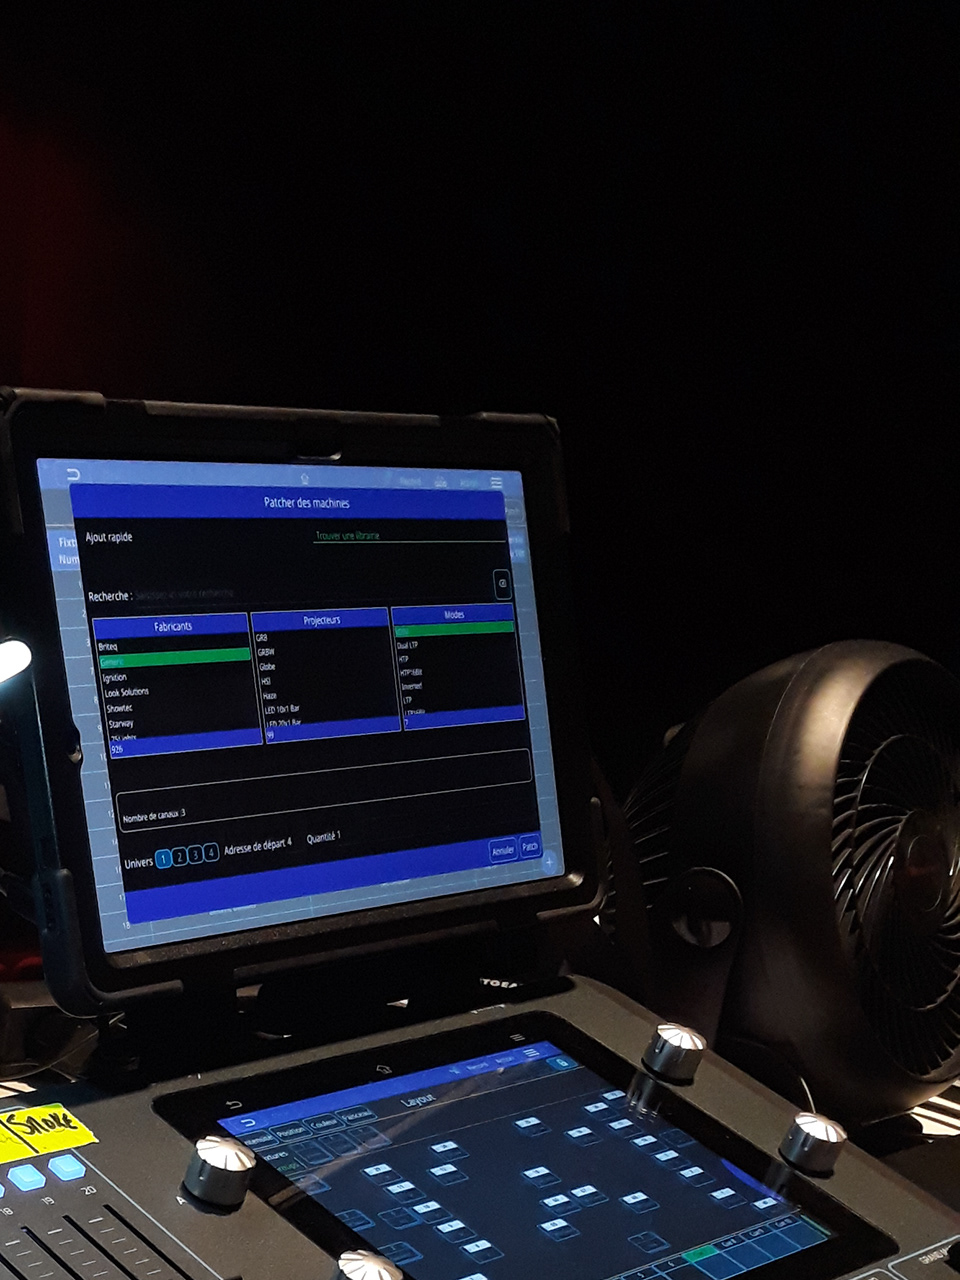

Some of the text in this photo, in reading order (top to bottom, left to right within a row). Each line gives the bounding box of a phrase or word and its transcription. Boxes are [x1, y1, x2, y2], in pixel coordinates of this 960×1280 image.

[264, 497, 351, 510] Patcher des machines
[86, 532, 133, 545] Ajout rapide
[88, 590, 129, 602] Recherche
[303, 615, 341, 627] Projecteurs
[444, 610, 465, 620] Modes
[154, 621, 193, 632] Fabricants
[98, 643, 119, 653] Briteq
[259, 663, 276, 671] Globe
[102, 672, 127, 684] Ignition
[104, 687, 150, 699] Look Solutions
[263, 692, 278, 700] Haze
[106, 703, 133, 714] Showtec
[108, 720, 134, 730] Starway
[111, 745, 123, 755] 926
[123, 808, 187, 825] Nombre de canaux 3
[306, 832, 336, 846] Quantité
[224, 837, 293, 856] Adresse de départ 4
[124, 857, 154, 870] Univers
[400, 1093, 437, 1108] Layout
[0, 1206, 14, 1217] 18
[41, 1195, 55, 1206] 19
[80, 1185, 98, 1196] 20
[175, 1196, 189, 1207] A
